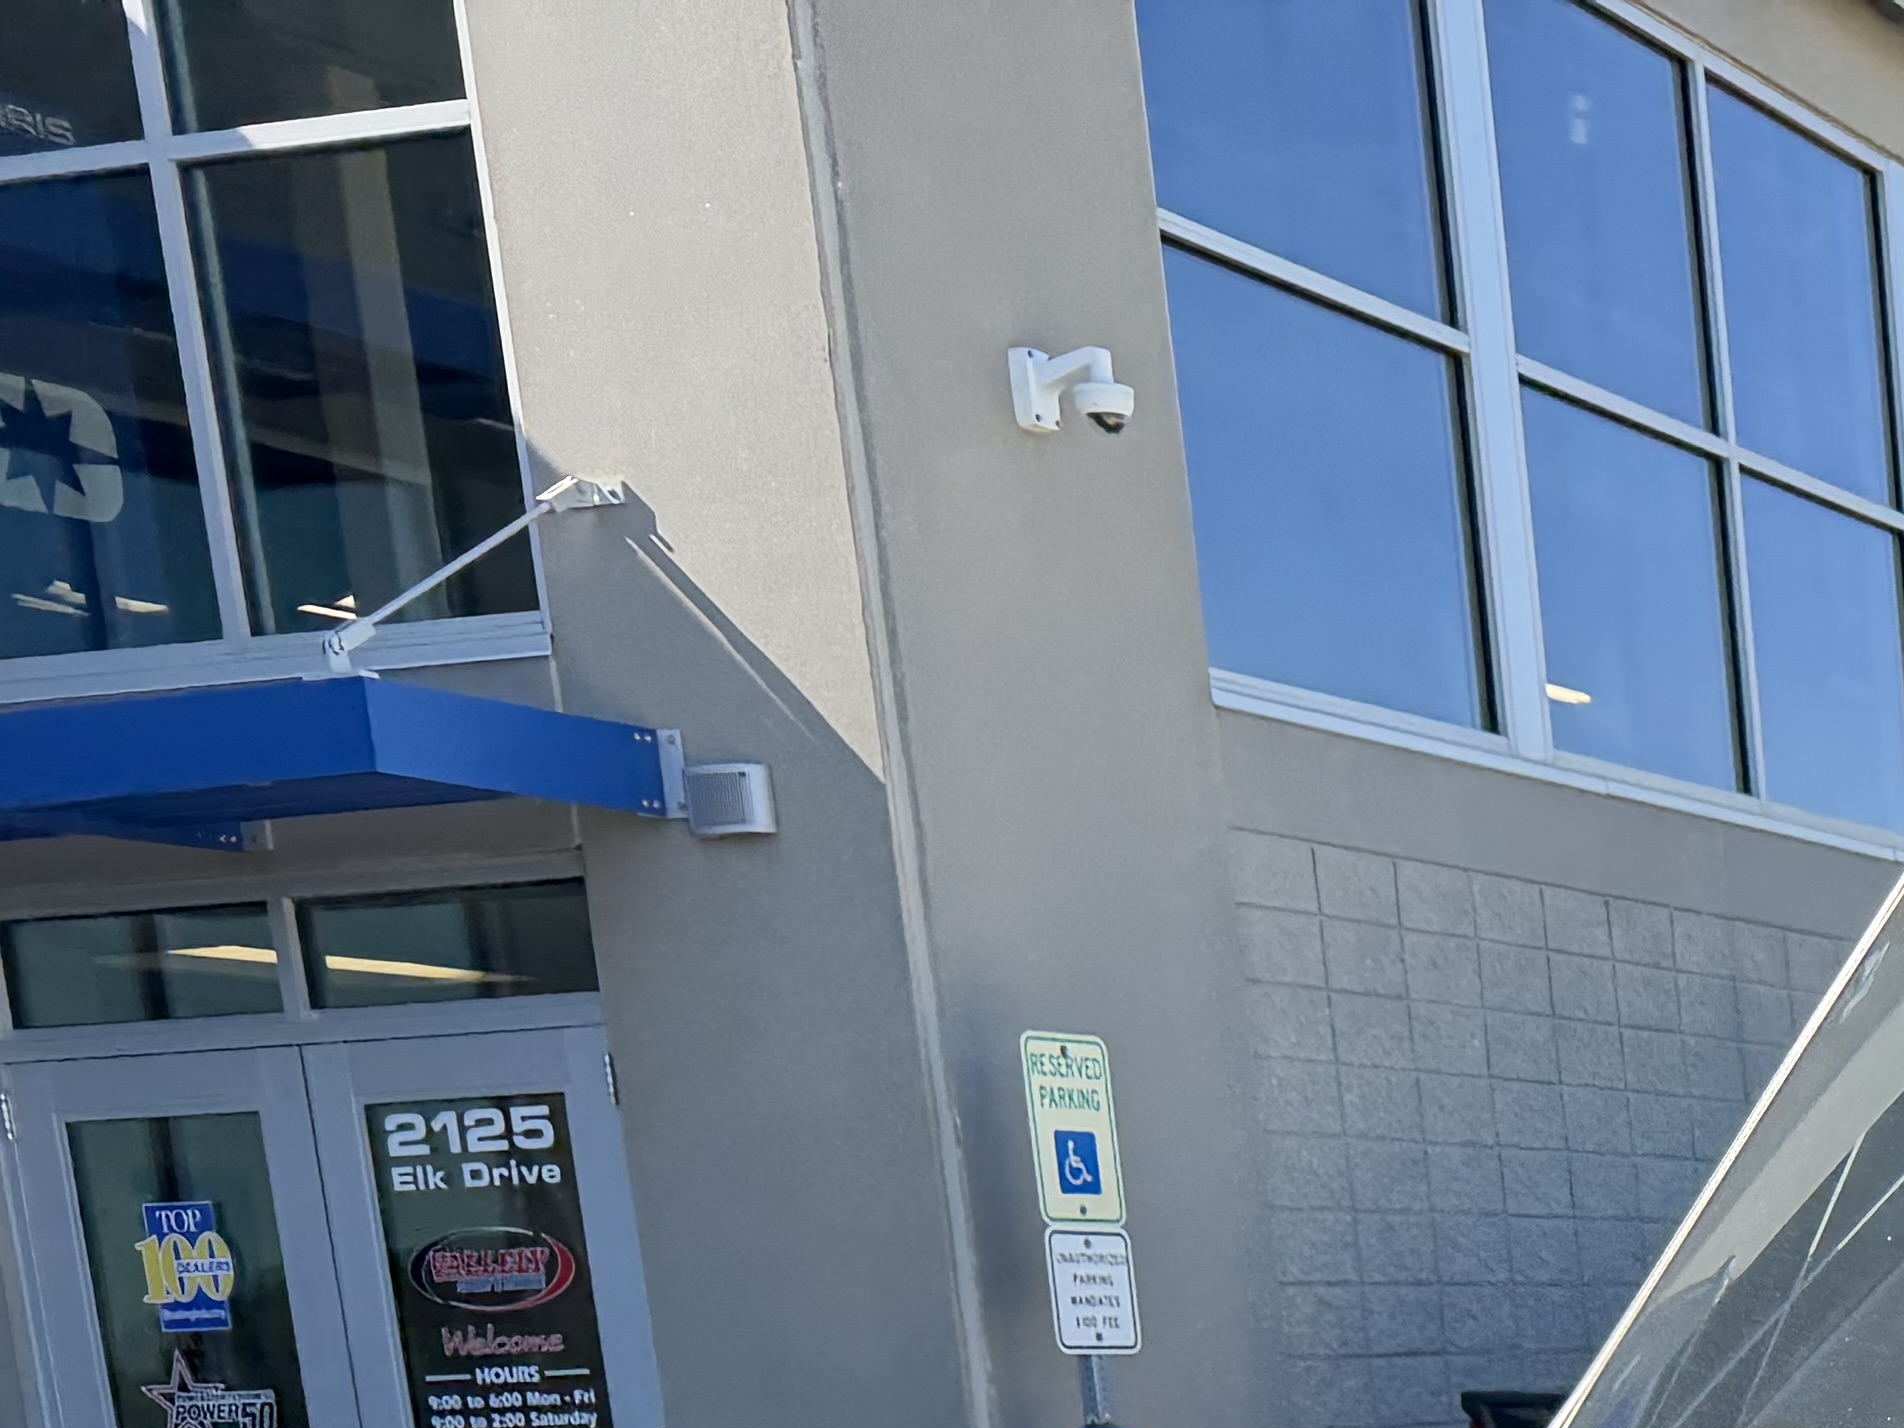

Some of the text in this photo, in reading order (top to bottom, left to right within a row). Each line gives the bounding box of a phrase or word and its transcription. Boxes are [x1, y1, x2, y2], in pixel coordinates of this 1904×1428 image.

[1028, 1052, 1102, 1081] RESERVED
[1038, 1086, 1101, 1112] PARKING
[384, 1104, 555, 1157] 2125
[390, 1159, 562, 1192] Elk Drive
[155, 1208, 202, 1234] TOP
[134, 1231, 235, 1304] 100
[441, 1323, 565, 1356] Welcome
[475, 1365, 541, 1385] HOURS
[467, 1395, 485, 1409] to
[526, 1391, 561, 1406] Mon
[573, 1388, 597, 1405] Fri
[175, 1402, 239, 1423] POWER
[470, 1415, 488, 1428] to
